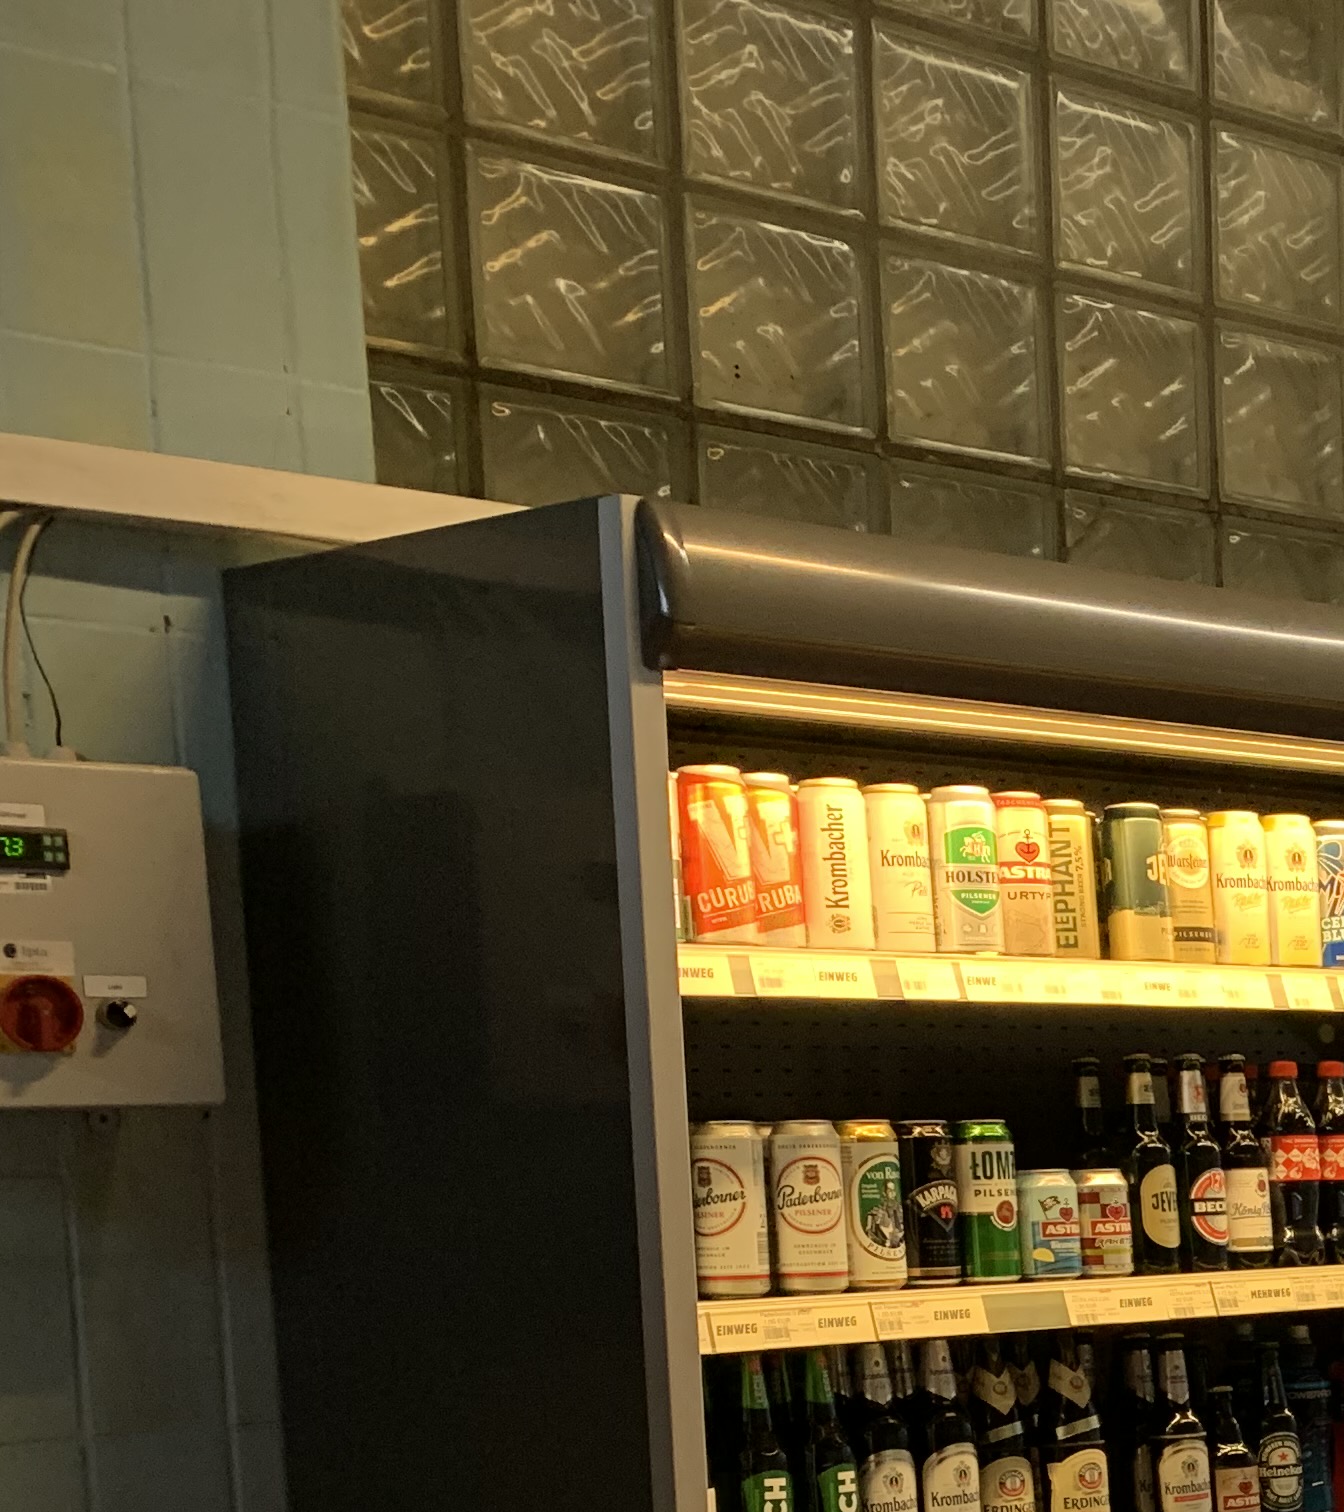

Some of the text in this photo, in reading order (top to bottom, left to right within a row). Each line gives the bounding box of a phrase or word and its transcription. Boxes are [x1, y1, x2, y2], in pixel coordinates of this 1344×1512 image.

[823, 804, 850, 909] Krombacher
[1000, 865, 1051, 880] ASTRA
[1048, 821, 1079, 950] ELEPHANT
[961, 893, 997, 901] PILSENER
[819, 971, 858, 982] EINWEG
[866, 1171, 883, 1180] von
[794, 1208, 832, 1217] PILSENER
[1250, 1288, 1291, 1299] MEHRWEG
[1119, 1297, 1153, 1308] EINWEG
[934, 1309, 971, 1321] EINWEG
[817, 1316, 857, 1328] EINWEG
[716, 1322, 758, 1336] EINWEG
